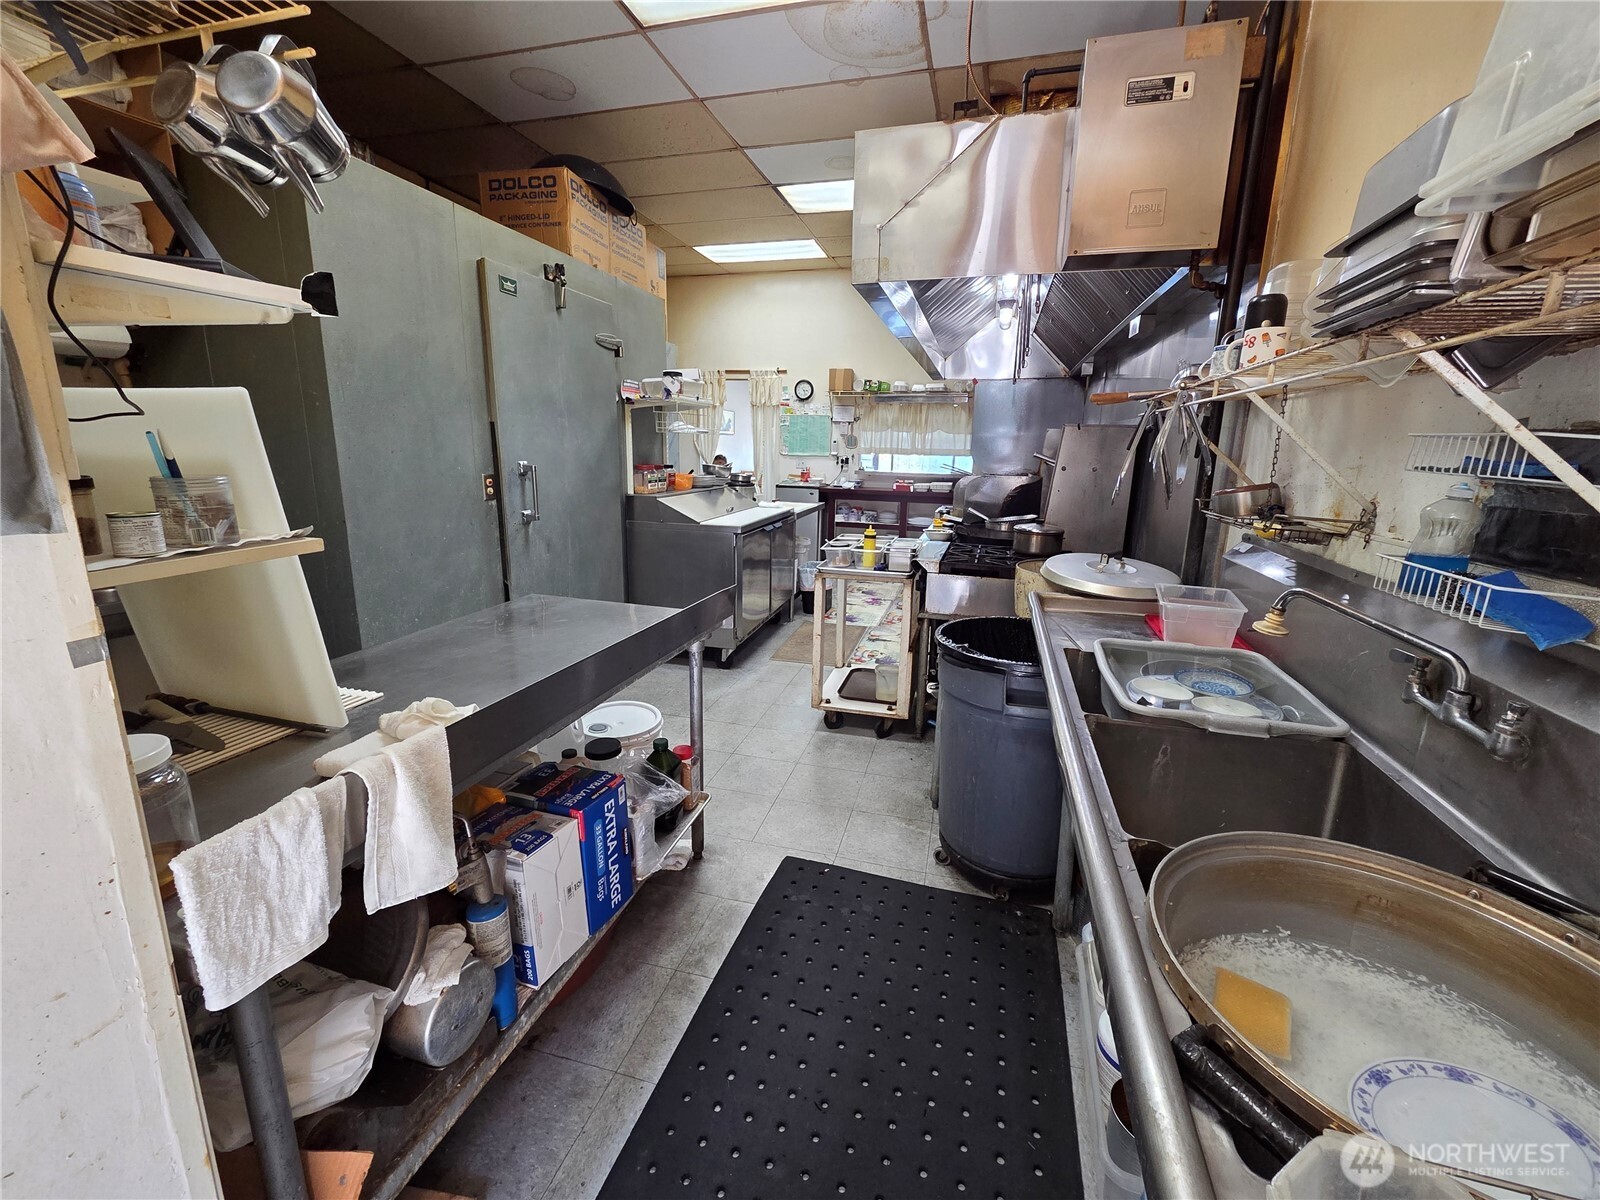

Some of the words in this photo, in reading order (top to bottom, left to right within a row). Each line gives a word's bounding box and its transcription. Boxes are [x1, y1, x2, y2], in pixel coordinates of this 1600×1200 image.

[488, 175, 556, 192] DOLCO
[489, 190, 557, 202] PACKAGING
[508, 212, 550, 221] HINGED-LID
[1129, 203, 1162, 214] ANSUL
[587, 773, 612, 790] EXTRA
[564, 789, 591, 807] LARGE
[595, 823, 602, 835] 33
[604, 798, 618, 855] EXTRA
[514, 833, 532, 843] 13
[534, 835, 547, 845] BAGS
[596, 836, 605, 869] GALLON
[597, 877, 605, 902] Bags
[608, 853, 622, 909] LARGE
